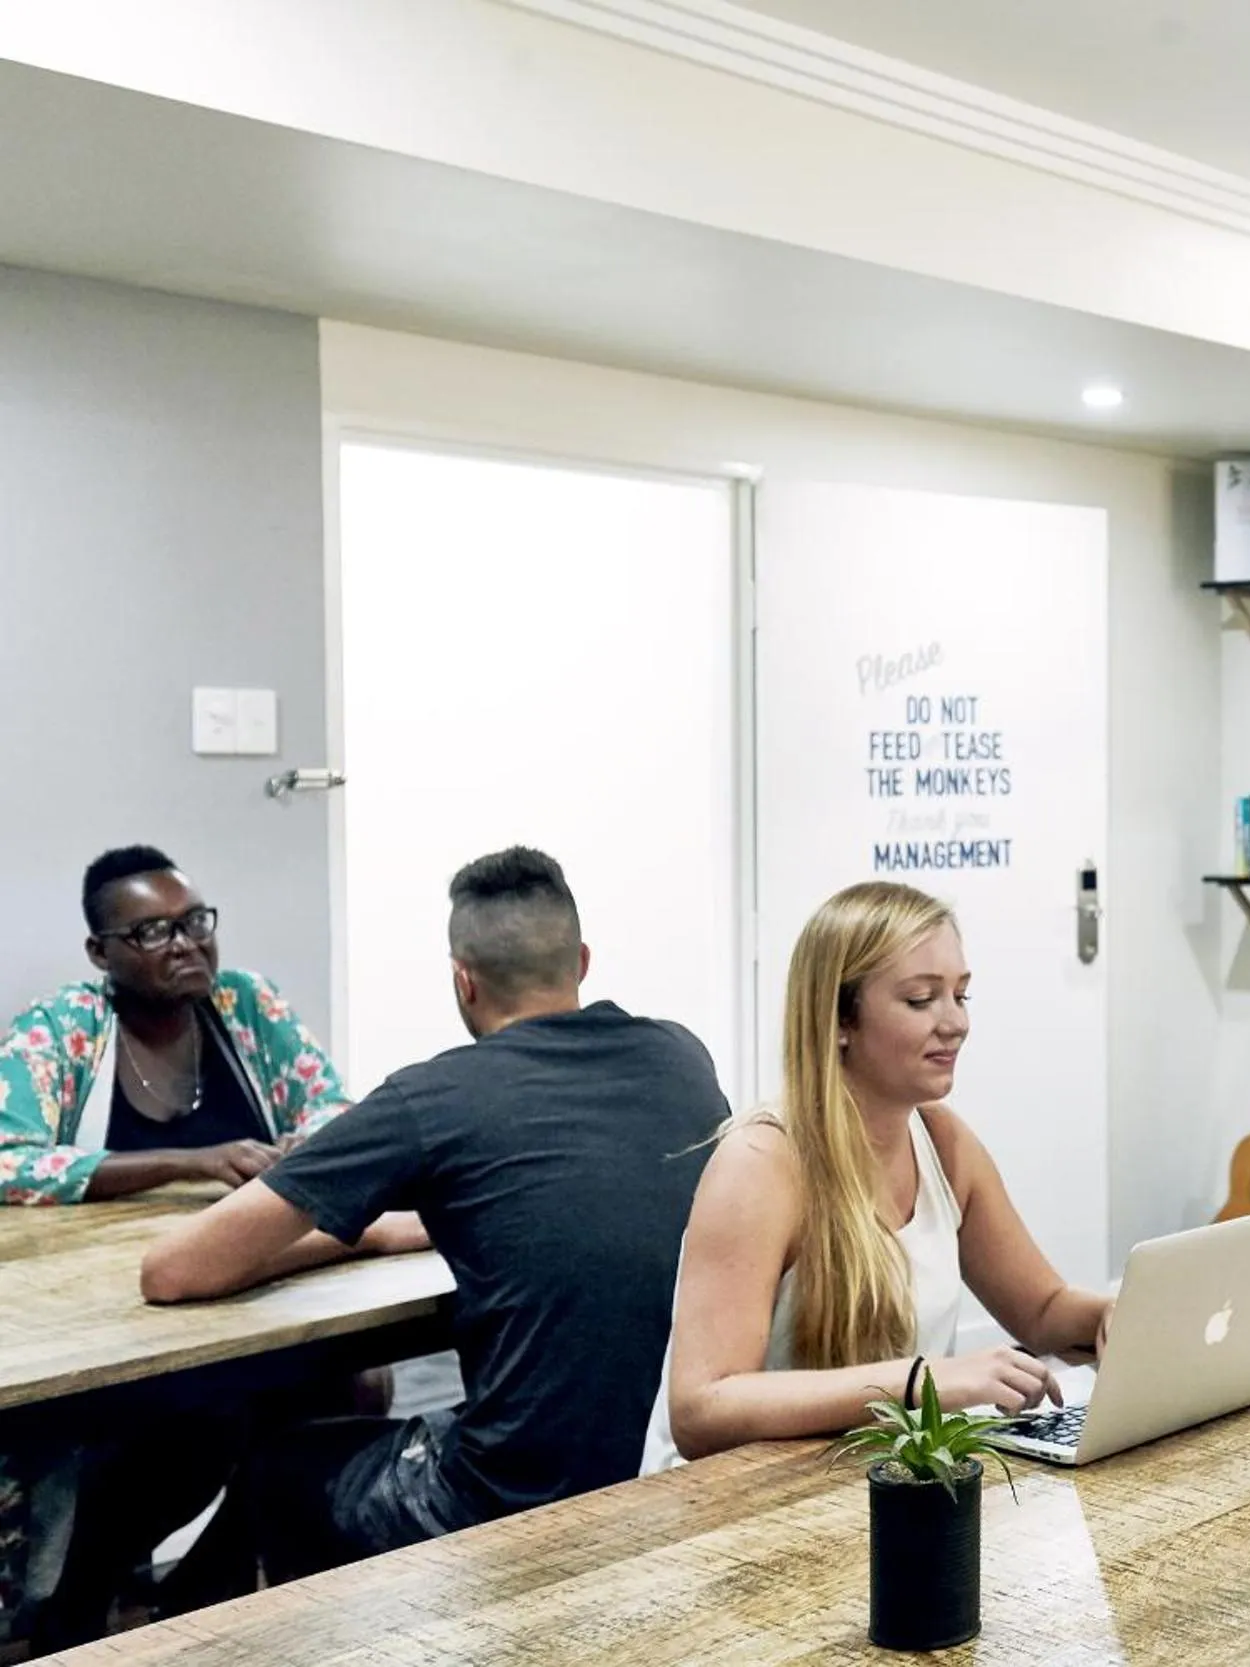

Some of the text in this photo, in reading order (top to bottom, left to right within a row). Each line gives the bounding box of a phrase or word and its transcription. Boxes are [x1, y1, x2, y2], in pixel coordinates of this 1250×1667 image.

[856, 641, 944, 696] Please
[906, 696, 978, 724] DO NOT
[869, 731, 921, 760] FEED
[942, 732, 1003, 760] TEASE
[865, 768, 1012, 797] THE MONKEYS
[873, 839, 1013, 871] MANAGEMENT
